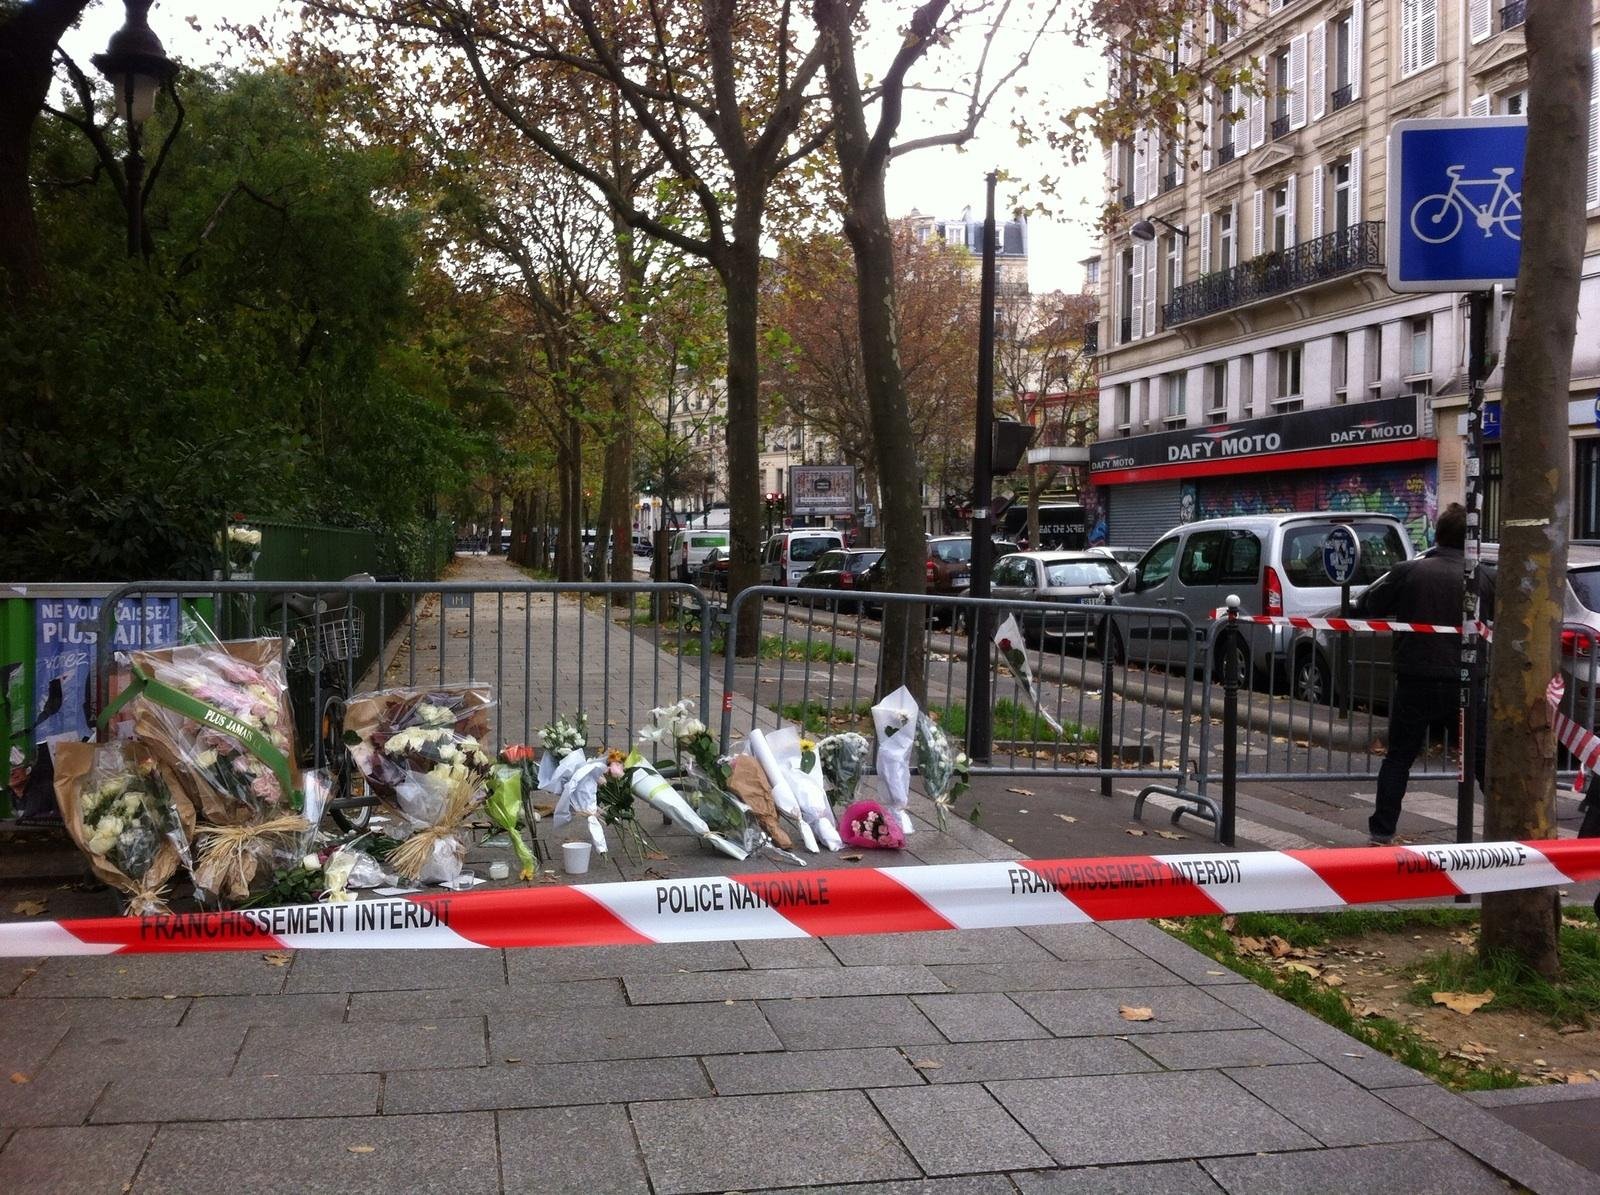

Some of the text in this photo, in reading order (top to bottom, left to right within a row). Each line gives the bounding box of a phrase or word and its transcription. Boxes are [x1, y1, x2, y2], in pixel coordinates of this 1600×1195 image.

[1168, 433, 1281, 461] DAFY MOTO
[1331, 425, 1413, 443] DAFY MOTO
[1091, 458, 1135, 470] DAFY MOTO
[42, 604, 170, 621] NE VOU AISSEZ
[42, 622, 170, 645] PLUS AIRE!
[204, 709, 255, 741] PLUS JAMAIS
[1394, 846, 1528, 875] POLICE NATIONALE
[1008, 858, 1242, 895] FRANCHISSEMENT INTERDIT
[656, 878, 830, 914] POLICE NATIONALE
[139, 899, 450, 940] FRANCHISSEMENT INTERDIT
